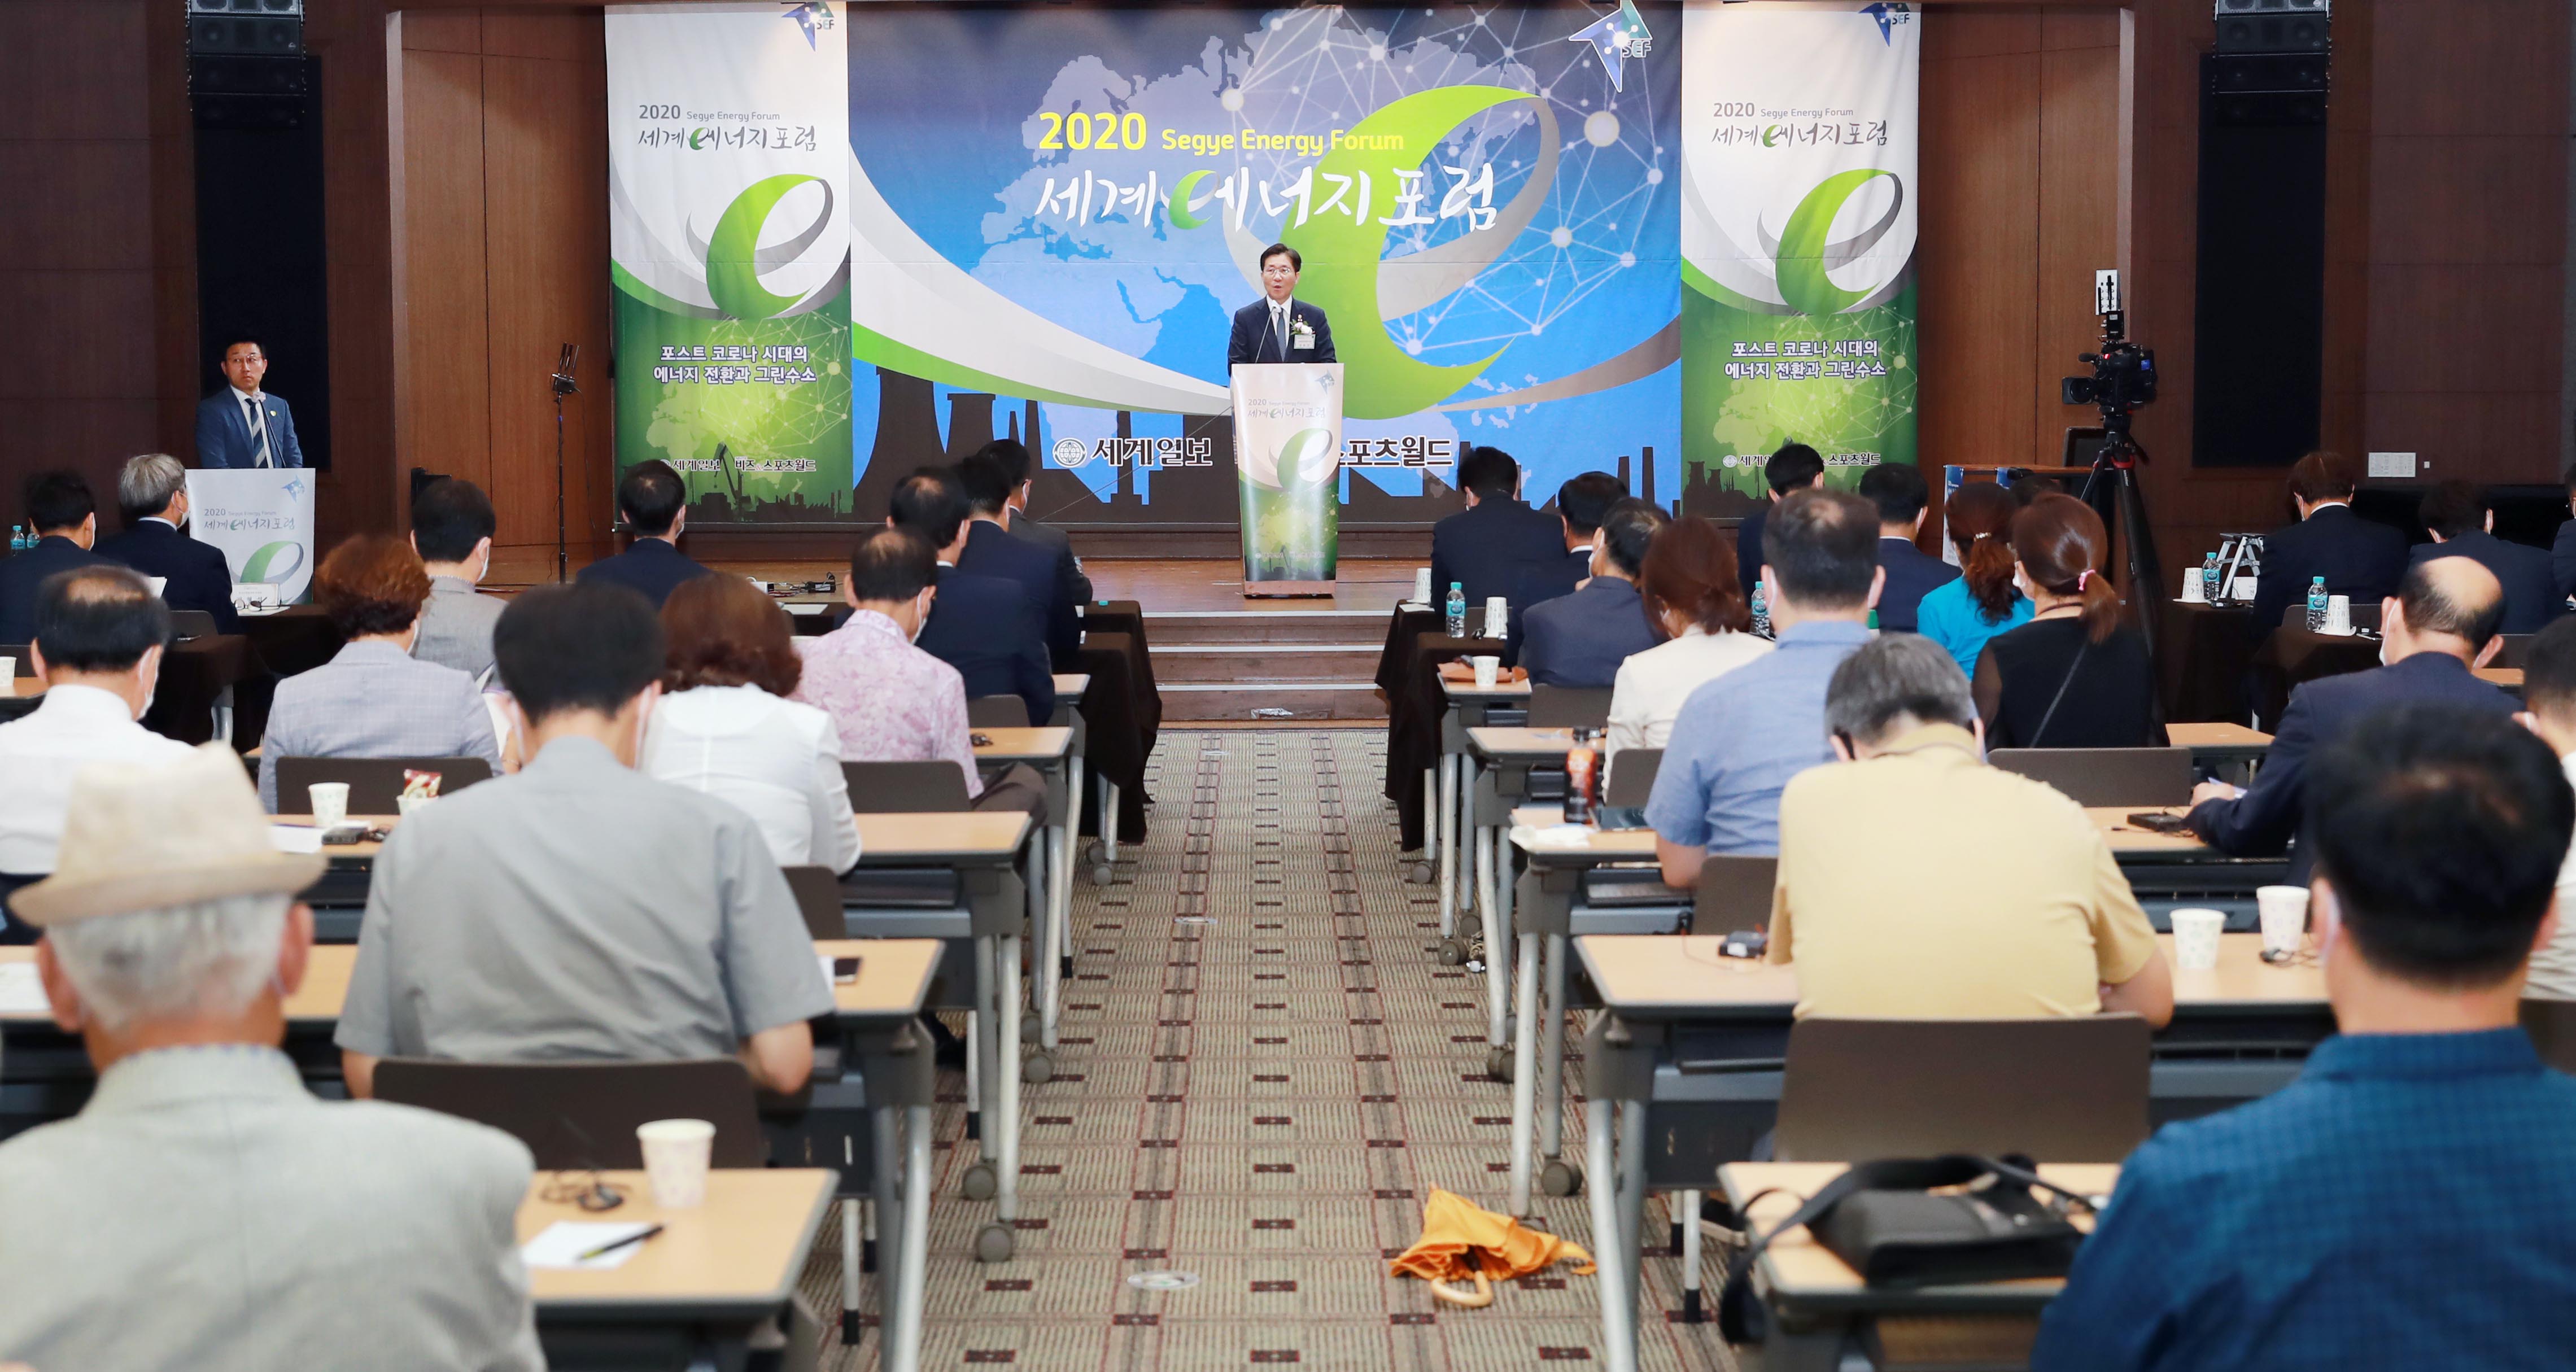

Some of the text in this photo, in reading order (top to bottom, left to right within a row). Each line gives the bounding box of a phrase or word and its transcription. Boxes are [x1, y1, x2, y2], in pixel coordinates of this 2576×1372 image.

[817, 19, 835, 30] SEF
[1892, 14, 1910, 24] SEF
[1622, 40, 1652, 58] SEF
[639, 105, 780, 122] 2020 Segye Energy Forum
[1713, 102, 1854, 119] 2020 Segye Energy Forum
[1039, 112, 1404, 156] 2020 Segye Energy Forum
[660, 345, 808, 363] 포스트 코로나 시대의
[1731, 340, 1879, 357] 포스트 코로나 시대의
[653, 366, 817, 384] 에너지 전환과 그린수소
[1724, 360, 1887, 379] 에너지 전환과 그린수소
[1091, 437, 1213, 467] 세계일보
[671, 459, 721, 471] 세계일보
[204, 508, 226, 517] 2020
